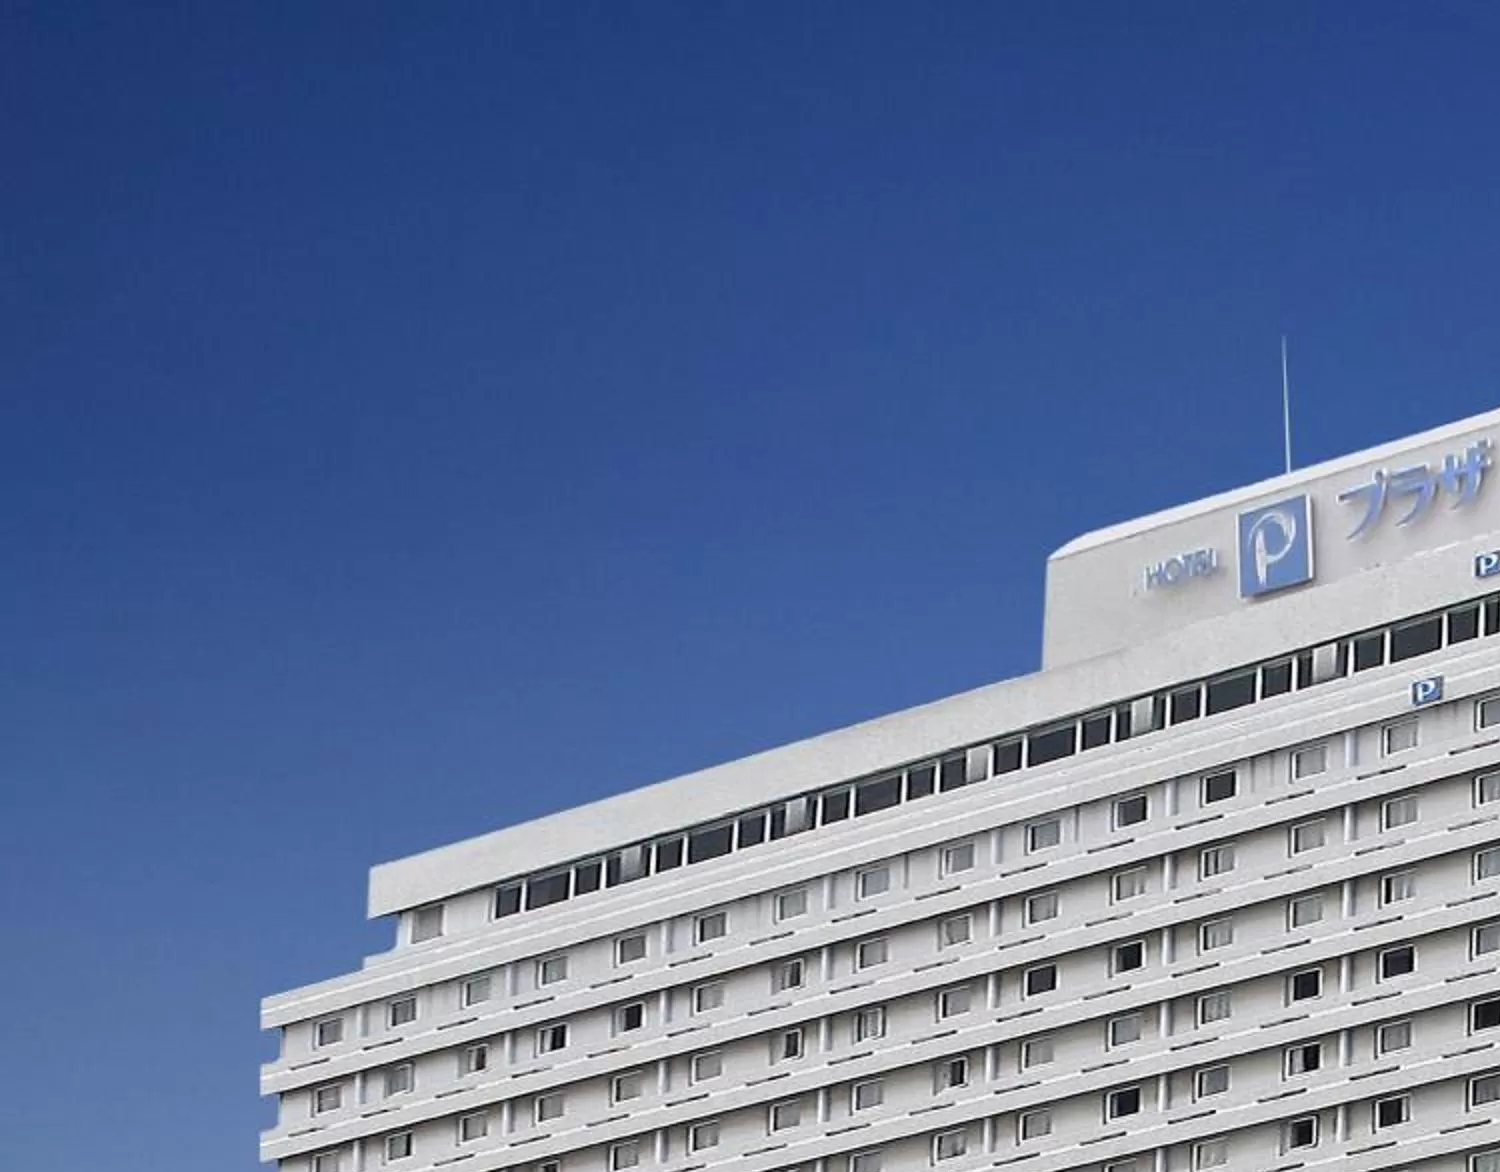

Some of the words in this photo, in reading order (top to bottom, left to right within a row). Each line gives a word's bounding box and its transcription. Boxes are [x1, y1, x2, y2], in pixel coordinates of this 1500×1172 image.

[1248, 509, 1297, 588] P
[1336, 438, 1494, 541] プラザ
